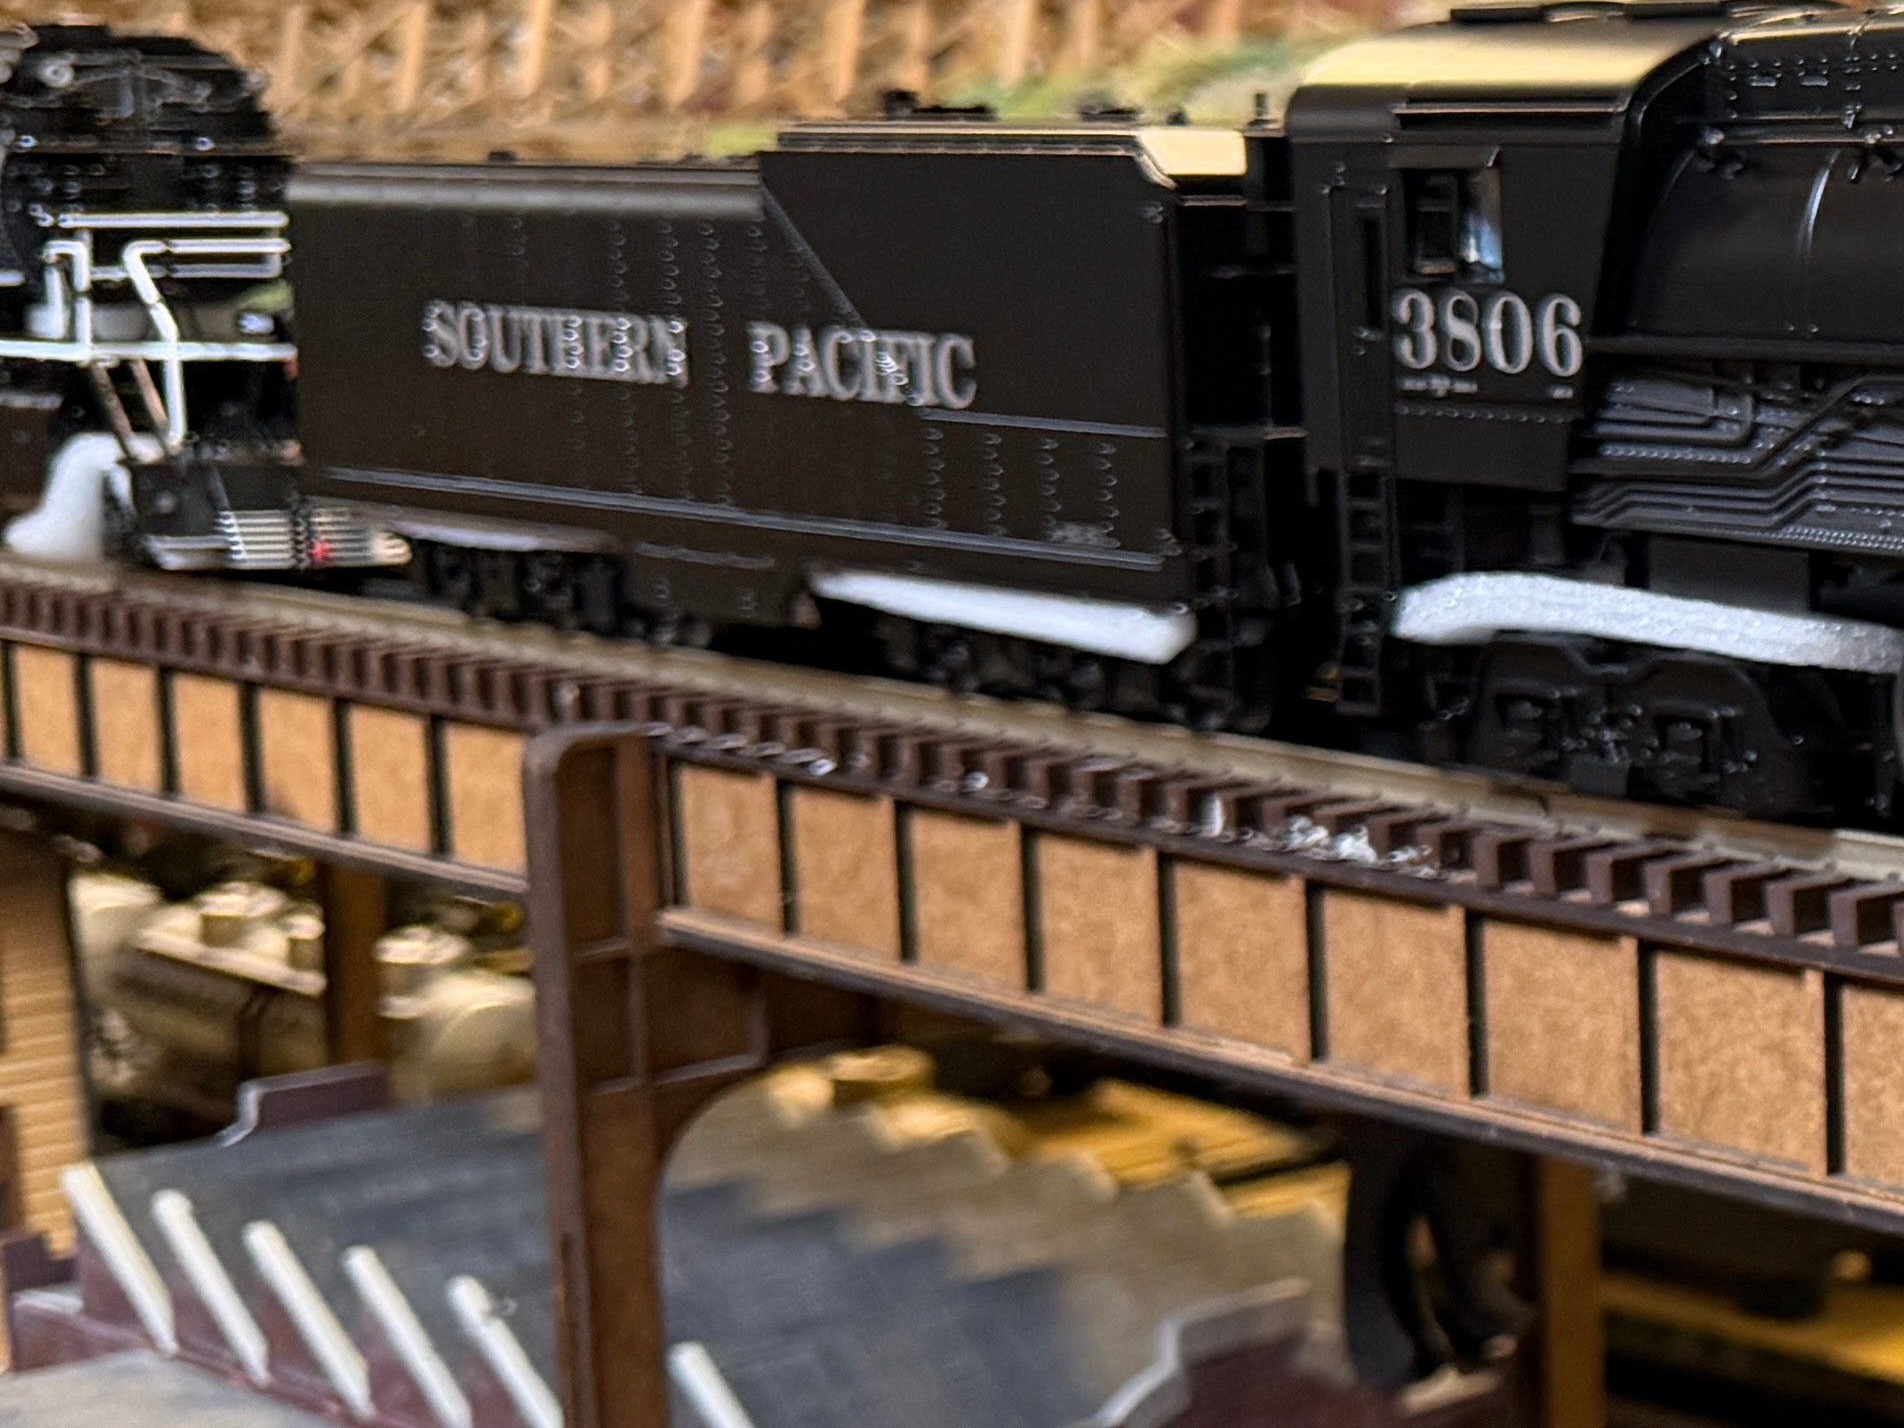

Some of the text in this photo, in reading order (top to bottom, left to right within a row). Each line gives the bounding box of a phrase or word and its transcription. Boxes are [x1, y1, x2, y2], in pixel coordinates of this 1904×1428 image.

[424, 299, 978, 410] SOUTHERN PACIFIC
[1394, 287, 1584, 378] 3806
